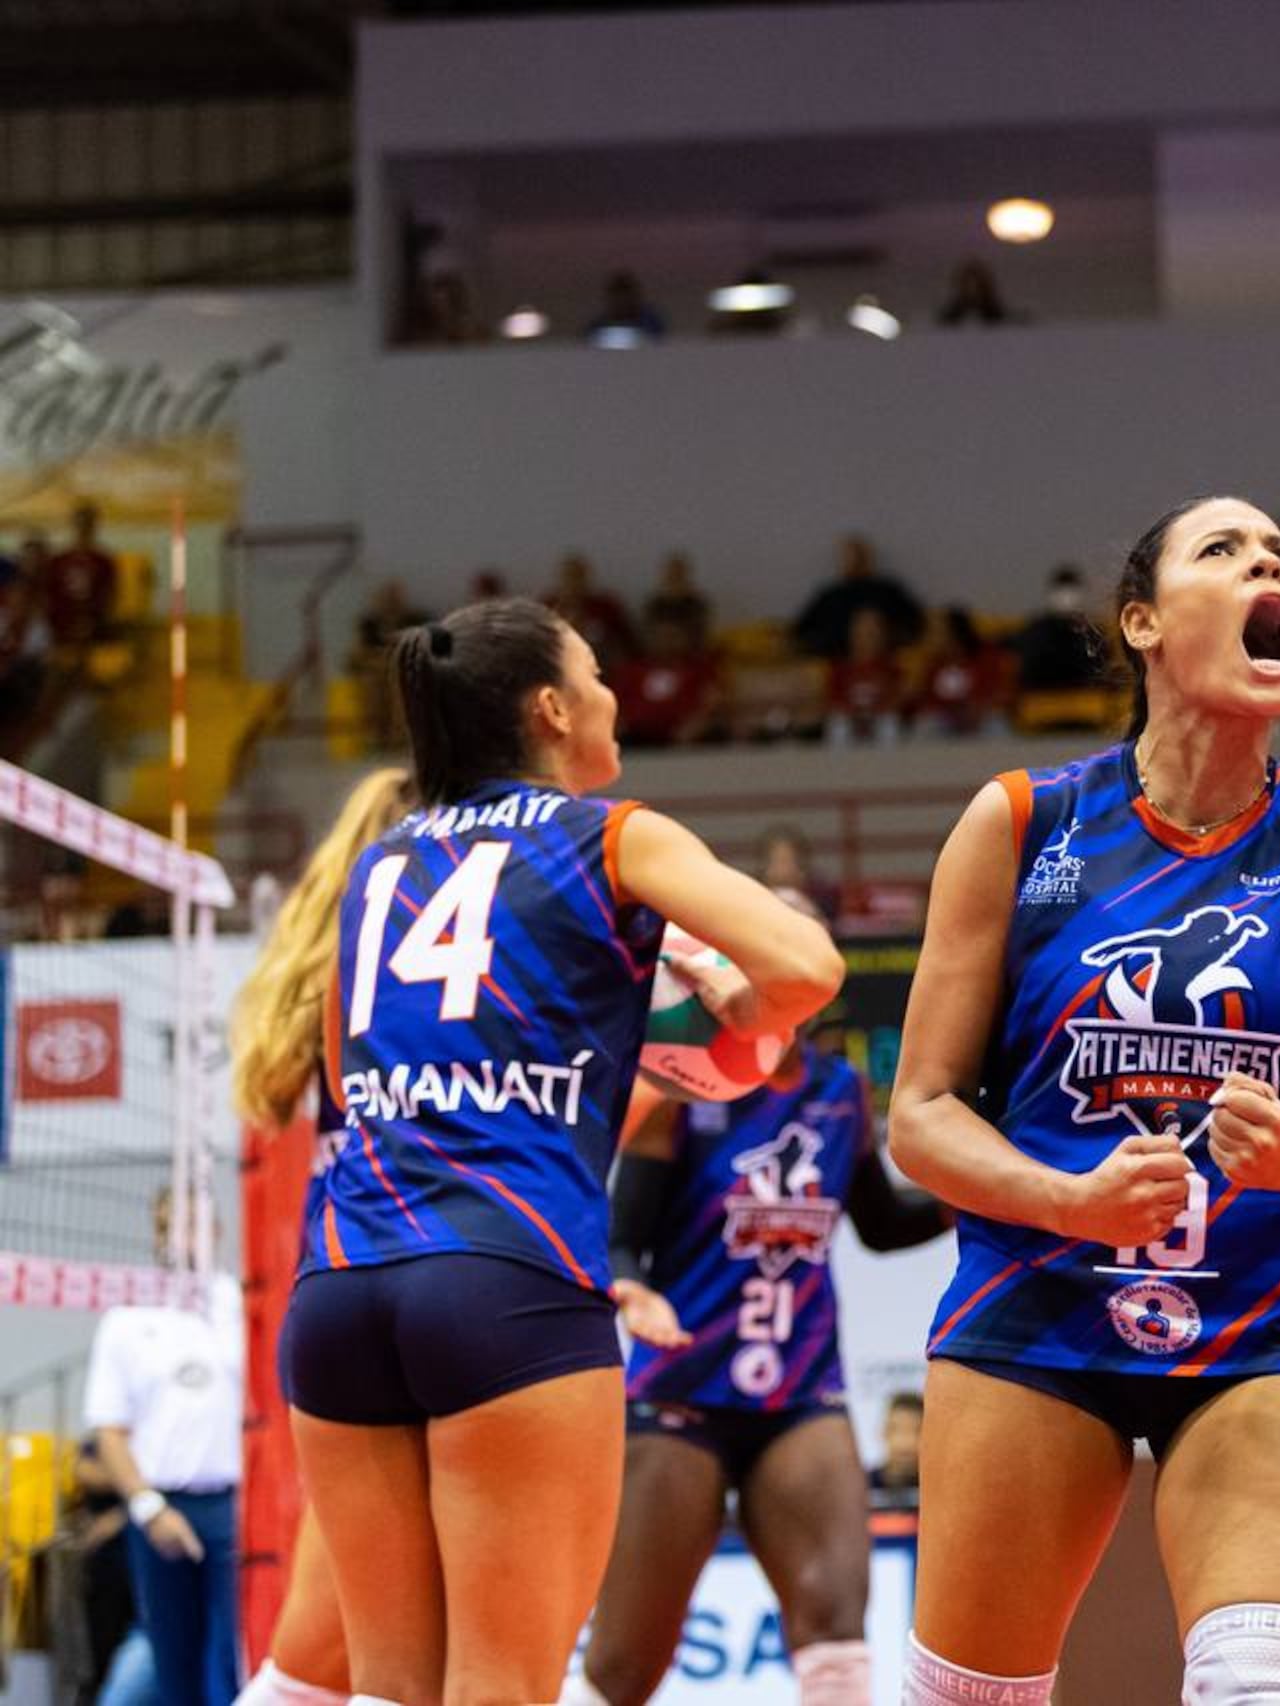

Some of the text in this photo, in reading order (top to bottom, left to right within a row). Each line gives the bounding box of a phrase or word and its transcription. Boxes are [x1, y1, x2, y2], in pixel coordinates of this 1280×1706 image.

[349, 841, 512, 1039] 14
[1077, 1030, 1272, 1083] ATENIENSES
[1122, 1079, 1215, 1099] MANAT
[738, 1277, 795, 1342] 21
